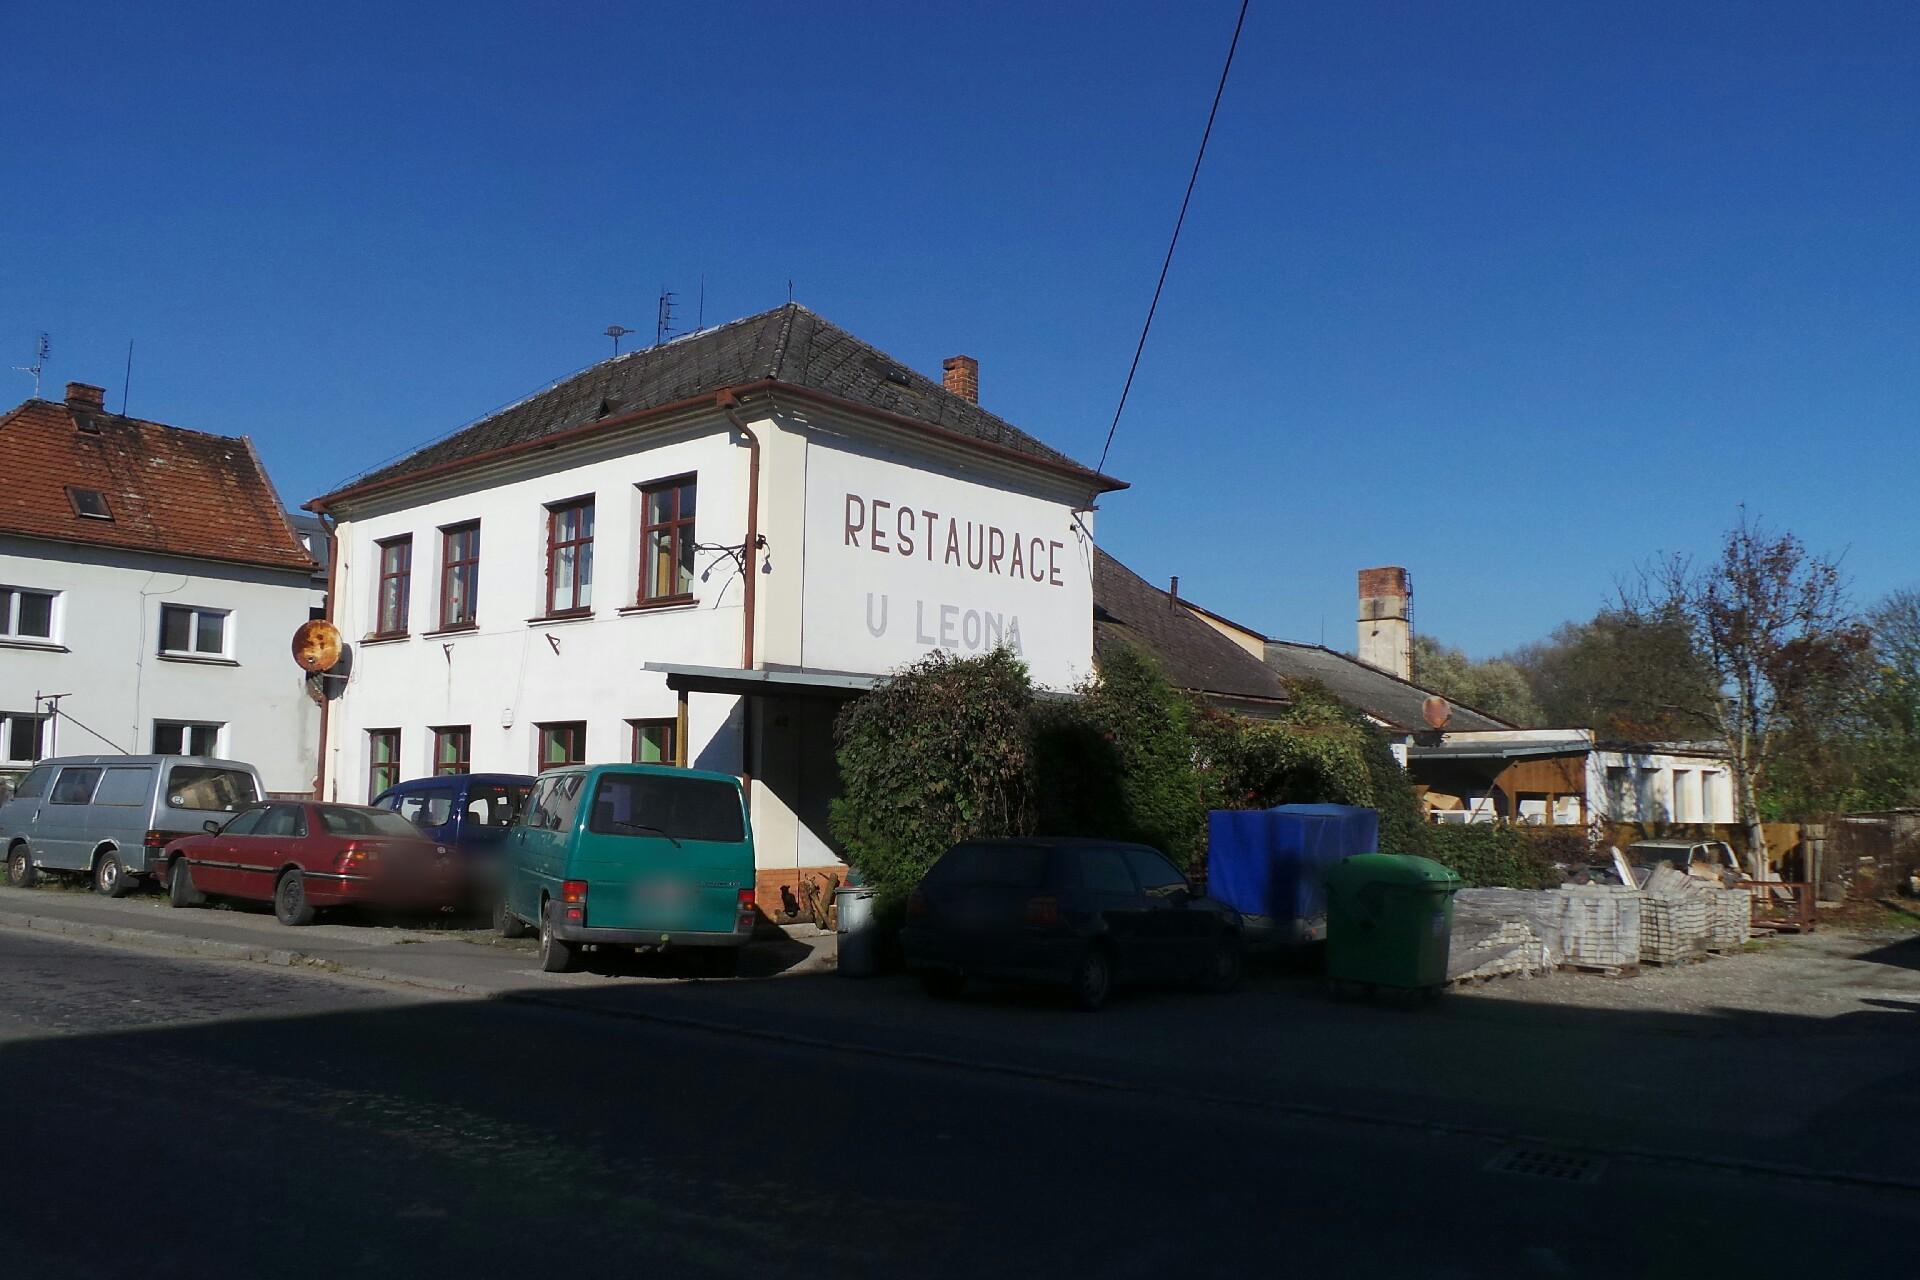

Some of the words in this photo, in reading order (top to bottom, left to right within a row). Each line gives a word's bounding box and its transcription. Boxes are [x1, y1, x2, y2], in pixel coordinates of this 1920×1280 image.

[844, 493, 1064, 587] RESTAURACE
[866, 592, 888, 639] U
[916, 600, 1023, 657] LEONA
